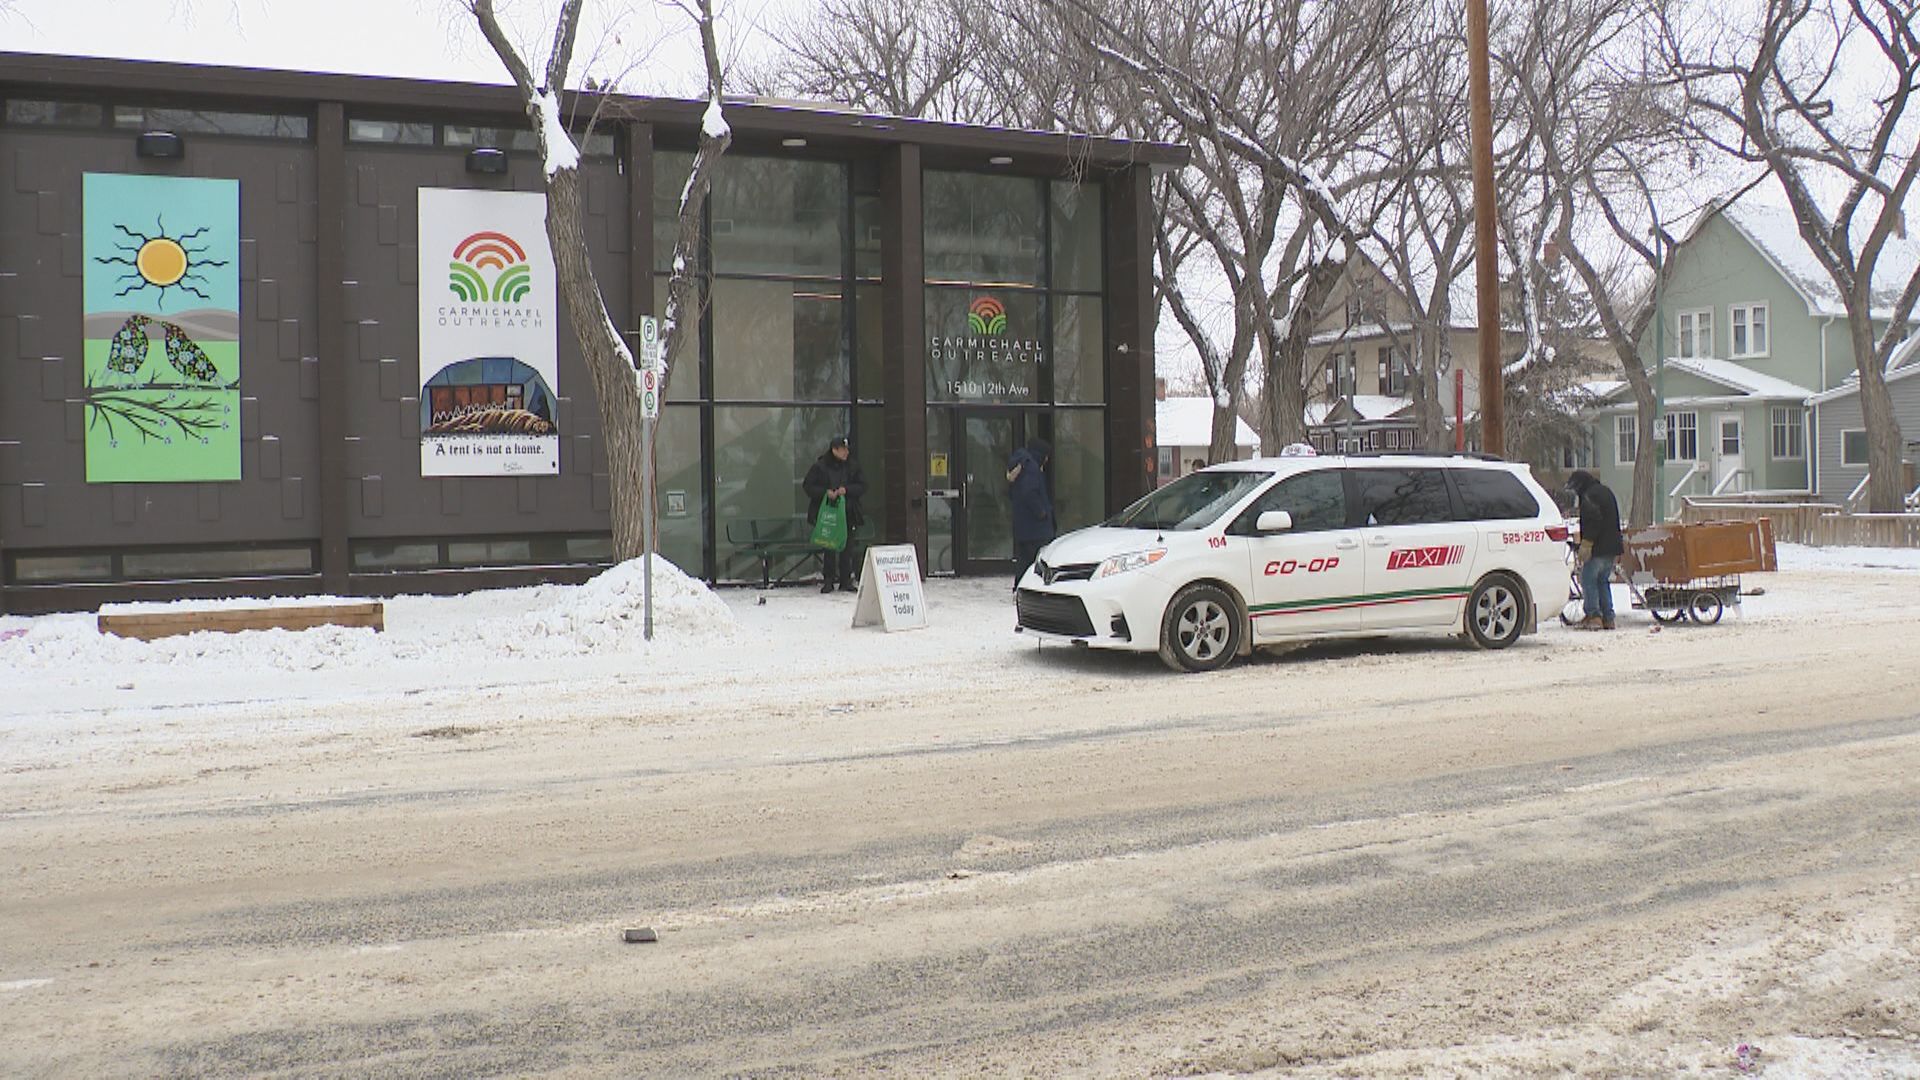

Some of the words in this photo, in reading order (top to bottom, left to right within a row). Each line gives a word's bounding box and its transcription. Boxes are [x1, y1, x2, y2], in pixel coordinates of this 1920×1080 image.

[438, 306, 541, 318] CARMICHAEL
[438, 317, 542, 328] OUTREACH
[931, 337, 1042, 350] CARMICHAEL
[931, 349, 1043, 363] OUTREACH
[947, 381, 977, 395] 1510
[981, 381, 1006, 395] 12th
[1008, 383, 1029, 396] Ave
[435, 443, 446, 456] A
[449, 444, 470, 455] tent
[472, 443, 483, 455] is
[486, 443, 502, 455] not
[505, 446, 512, 454] a
[514, 443, 545, 455] home.
[1208, 536, 1227, 549] 104
[1393, 548, 1441, 569] TAXI
[1264, 557, 1339, 576] CO-OP
[885, 570, 910, 584] Nurse
[893, 591, 910, 602] Here
[893, 604, 915, 617] Today
